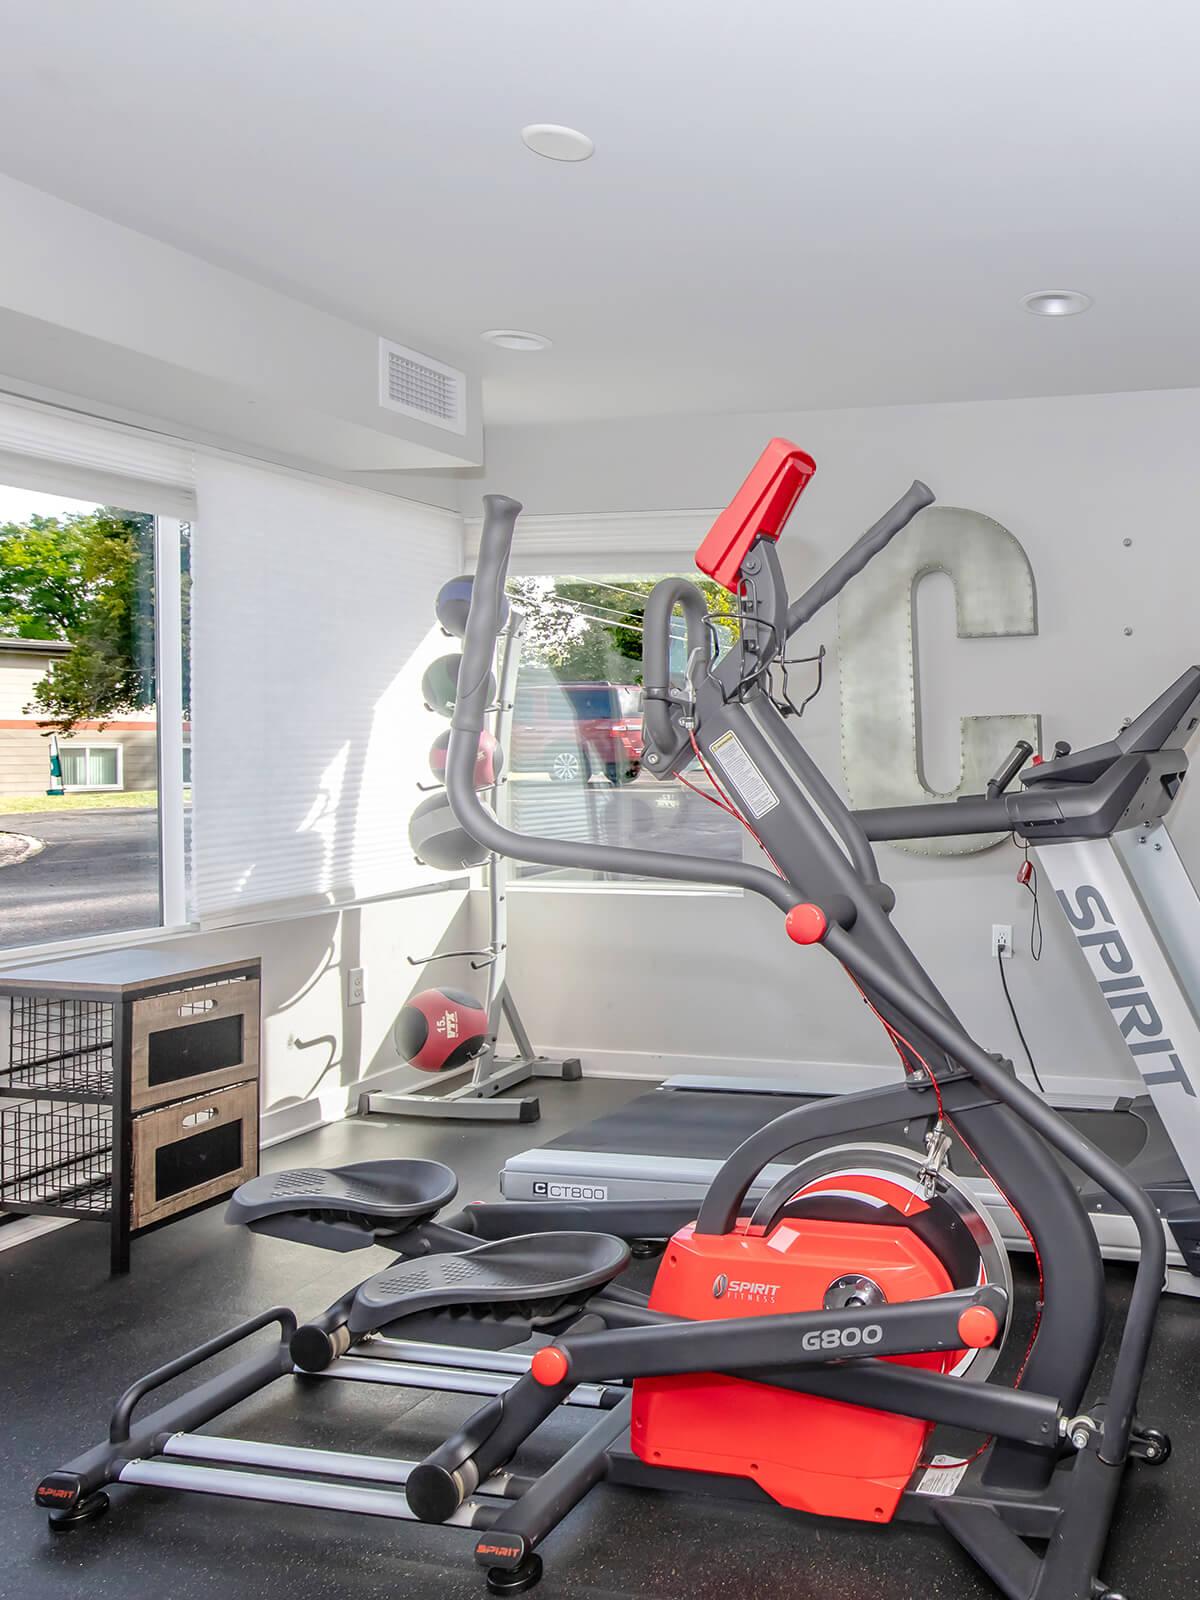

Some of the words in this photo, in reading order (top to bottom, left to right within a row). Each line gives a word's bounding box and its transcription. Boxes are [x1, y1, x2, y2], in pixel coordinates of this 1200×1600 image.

[1055, 884, 1198, 1098] SPIRIT
[550, 1185, 605, 1200] CT800
[728, 1280, 782, 1297] SPIRIT
[727, 1291, 776, 1304] FITNESS
[802, 1324, 883, 1351] G800
[38, 1486, 75, 1499] SPIRIT
[476, 1544, 520, 1558] SPIRIT
